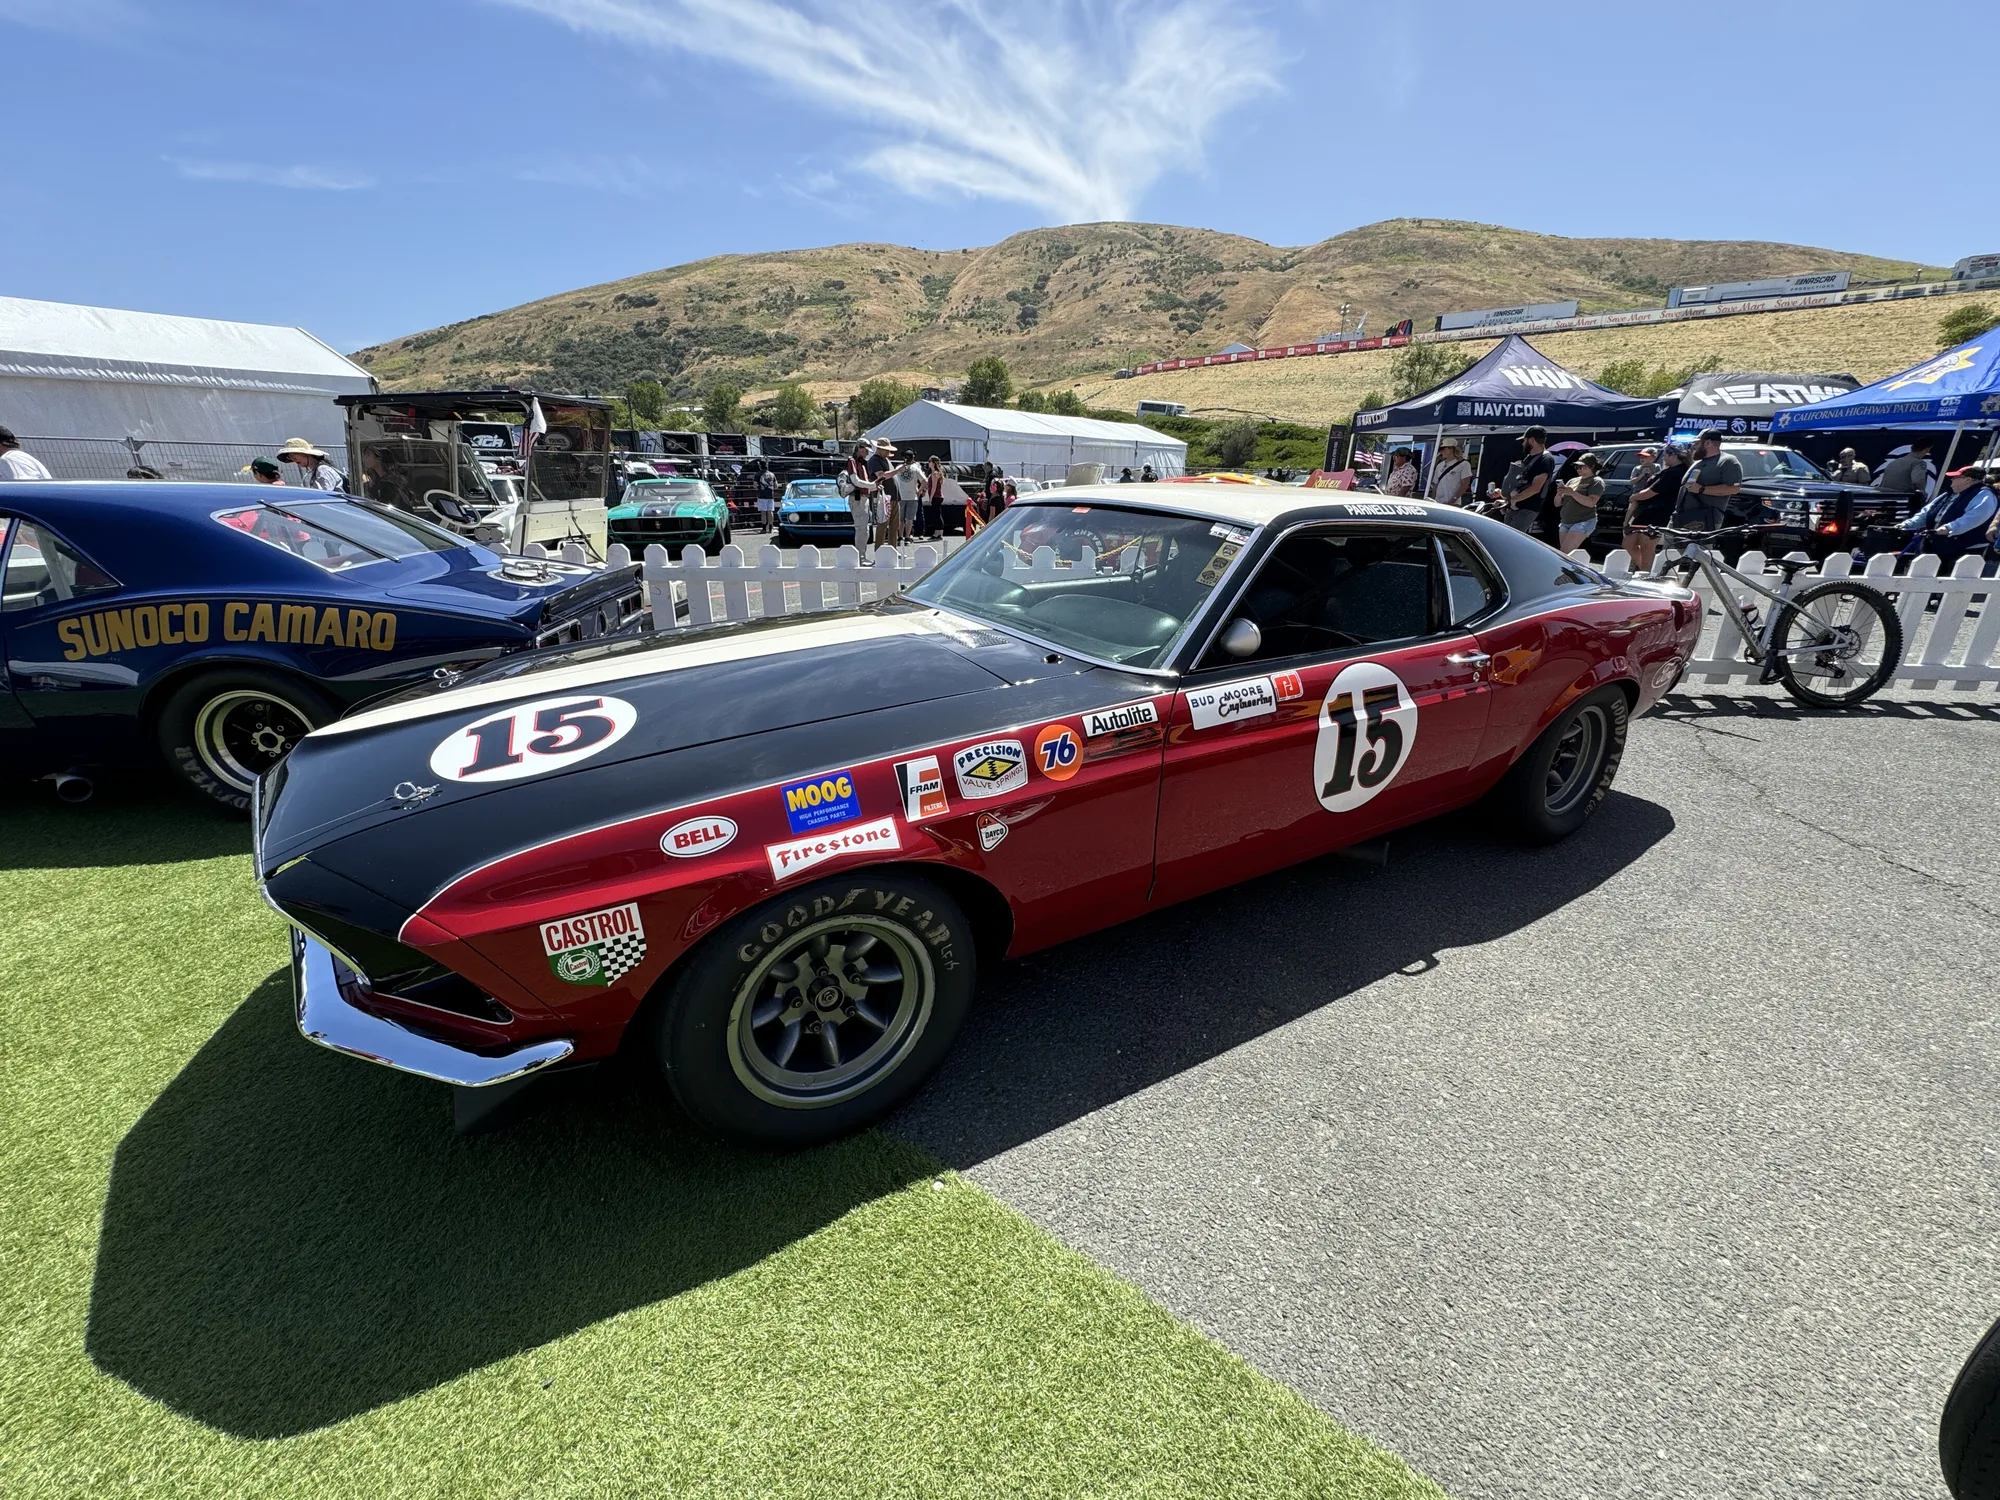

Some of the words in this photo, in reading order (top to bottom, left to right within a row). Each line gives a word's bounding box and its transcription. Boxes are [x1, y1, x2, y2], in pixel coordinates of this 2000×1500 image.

[1798, 275, 1837, 285] NASCAR
[1715, 305, 1739, 314] Save
[1739, 302, 1766, 311] Mart
[1774, 299, 1799, 308] Save
[1799, 296, 1829, 306] Mart
[1495, 309, 1524, 317] NASCAR
[1607, 315, 1627, 323] Save
[1627, 313, 1652, 322] Mart
[1660, 310, 1680, 319] Save
[1681, 308, 1707, 316] Mart
[1507, 326, 1526, 334] Save
[1525, 324, 1547, 332] Mart
[1555, 321, 1575, 329] Save
[1574, 319, 1597, 327] Mart
[1475, 329, 1498, 337] Mart
[1500, 366, 1589, 392] NAVY
[1474, 404, 1545, 418] NAVY.COM
[1793, 409, 1843, 422] CALIFORNIA
[1848, 404, 1890, 416] HIGHWAY
[1892, 401, 1931, 414] PATROL
[1675, 418, 1727, 430] EATWAVE
[1343, 504, 1396, 516] PARNELLI
[1395, 504, 1428, 516] JONES
[57, 602, 209, 661] SUNOCO
[1191, 695, 1215, 708] BUD
[1224, 685, 1263, 702] MOORE
[1218, 694, 1273, 718] Engineering
[1092, 706, 1153, 734] Autolite
[458, 698, 616, 778] 15
[1321, 683, 1403, 799] 15
[958, 745, 1022, 769] PRECISION
[1040, 731, 1077, 771] 76
[962, 777, 993, 790] VALVE
[996, 765, 1024, 789] SPRINGS
[786, 777, 852, 812] MOOG
[910, 781, 939, 795] FRAM
[799, 812, 812, 820] HIGH
[813, 803, 849, 817] PERFORMANCE
[923, 801, 943, 812] FILTERS
[807, 815, 829, 825] CHASSIS
[829, 811, 847, 820] PARTS
[673, 824, 727, 849] BELL
[985, 828, 1005, 840] DAYCO
[776, 827, 891, 869] Firestone
[545, 907, 639, 951] CASTROL
[569, 958, 589, 972] Castrol
